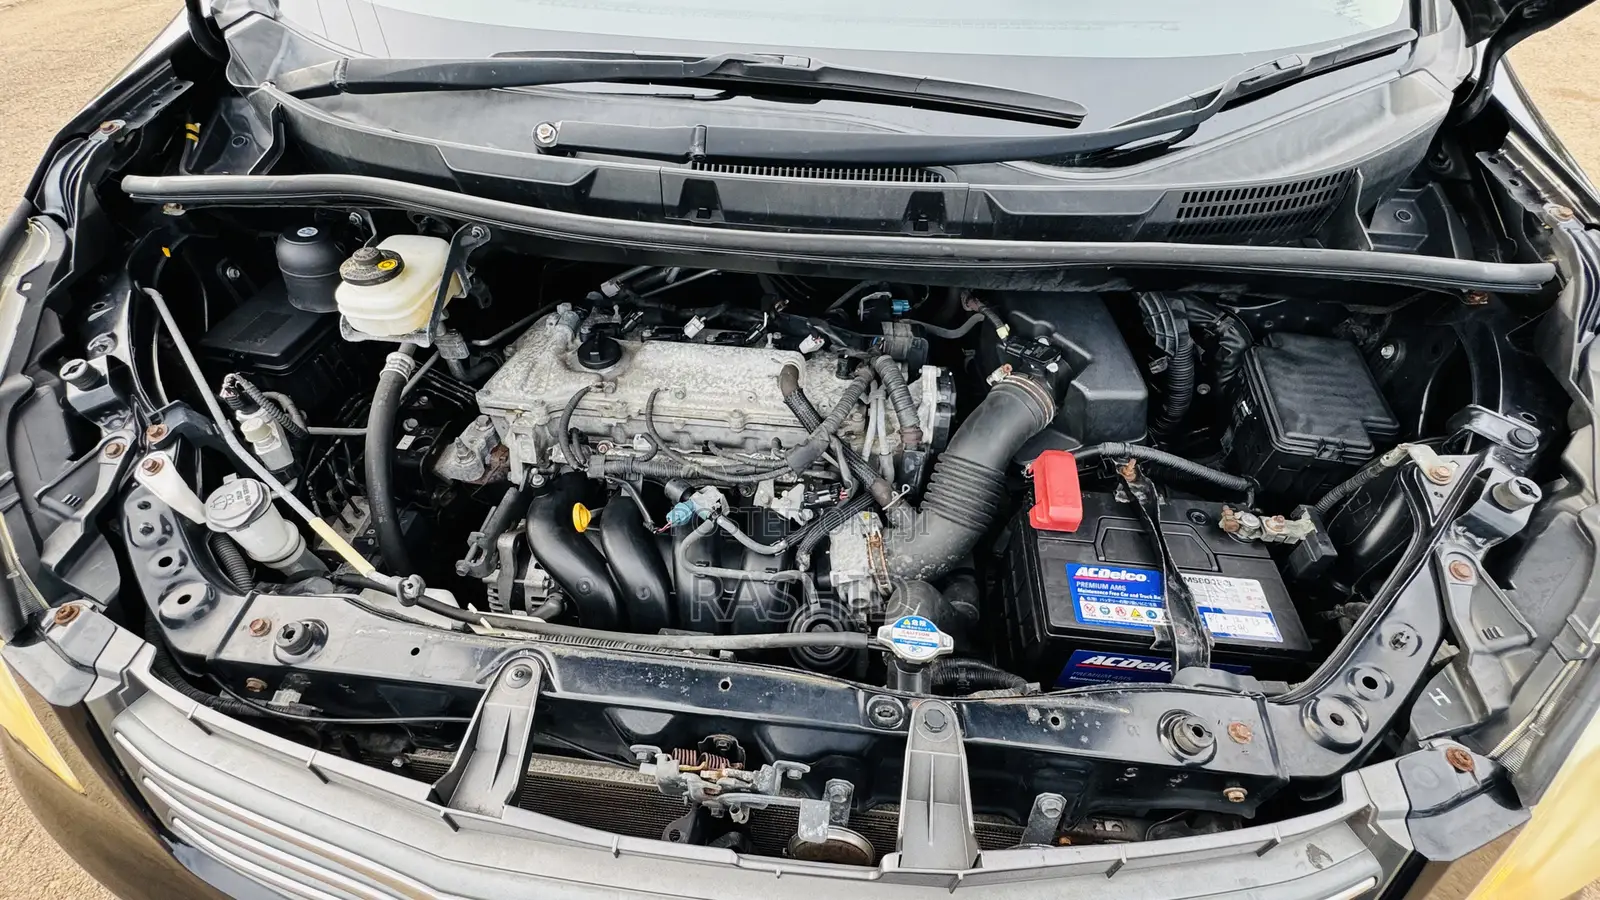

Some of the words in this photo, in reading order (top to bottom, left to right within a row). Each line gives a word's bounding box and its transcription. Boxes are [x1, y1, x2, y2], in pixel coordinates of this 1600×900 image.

[1075, 566, 1147, 582] ACDelco
[1076, 581, 1109, 590] PREMIUM
[1110, 584, 1127, 592] AMS
[1081, 655, 1172, 672] ACDelc
